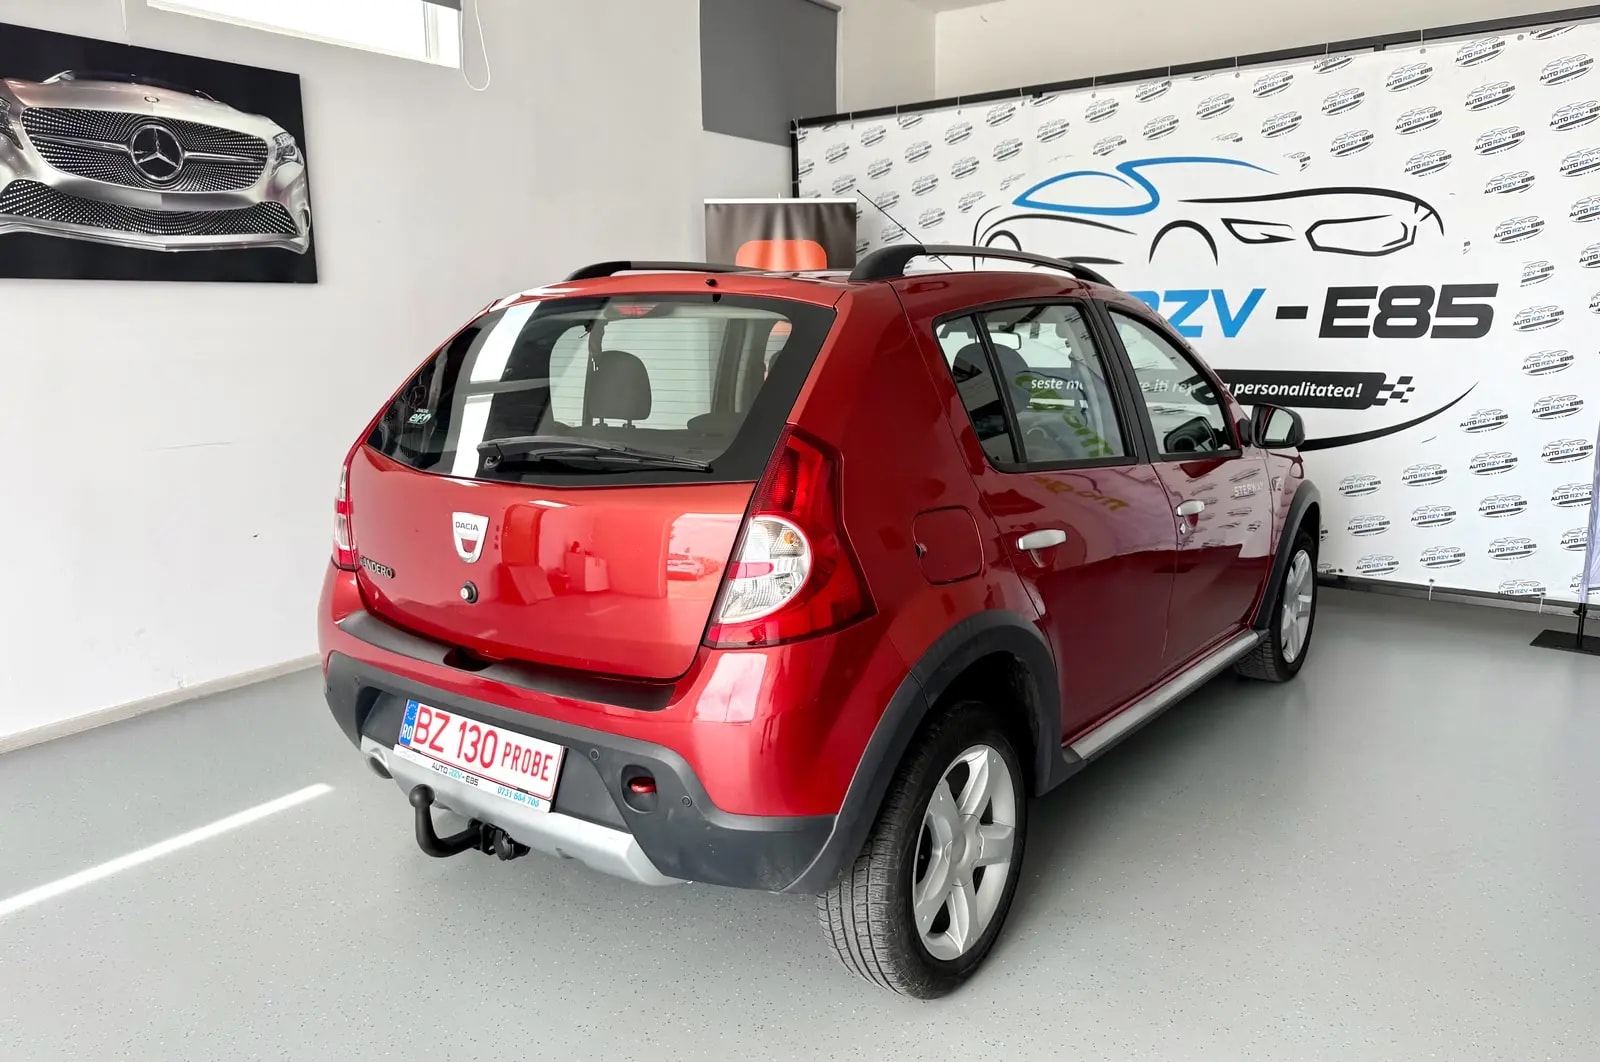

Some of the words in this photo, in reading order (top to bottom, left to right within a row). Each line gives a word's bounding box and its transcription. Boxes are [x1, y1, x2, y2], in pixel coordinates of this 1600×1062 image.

[1455, 52, 1473, 63] AUTO
[1540, 70, 1558, 81] AUTO
[1386, 77, 1402, 87] AUTO
[1465, 96, 1482, 107] AUTO
[1395, 120, 1412, 130] AUTO
[1550, 116, 1568, 127] AUTO
[1474, 140, 1492, 151] AUTO
[1405, 163, 1421, 173] AUTO
[1559, 162, 1578, 172] AUTO
[1484, 184, 1502, 194] AUTO
[1569, 208, 1588, 217] AUTO
[1494, 229, 1511, 238] AUTO
[1579, 254, 1598, 263] AUTO
[1318, 283, 1499, 339] E85
[1513, 318, 1531, 326] AUTO
[1522, 362, 1540, 370] AUTO
[1233, 382, 1363, 398] personalitatea!
[1532, 406, 1550, 414] AUTO
[1460, 419, 1477, 427] AUTO
[455, 521, 479, 533] DACIA
[402, 724, 413, 740] RO
[413, 706, 450, 753] BZ
[456, 720, 498, 769] 130
[501, 741, 553, 782] PROBE
[432, 762, 448, 776] AUTO
